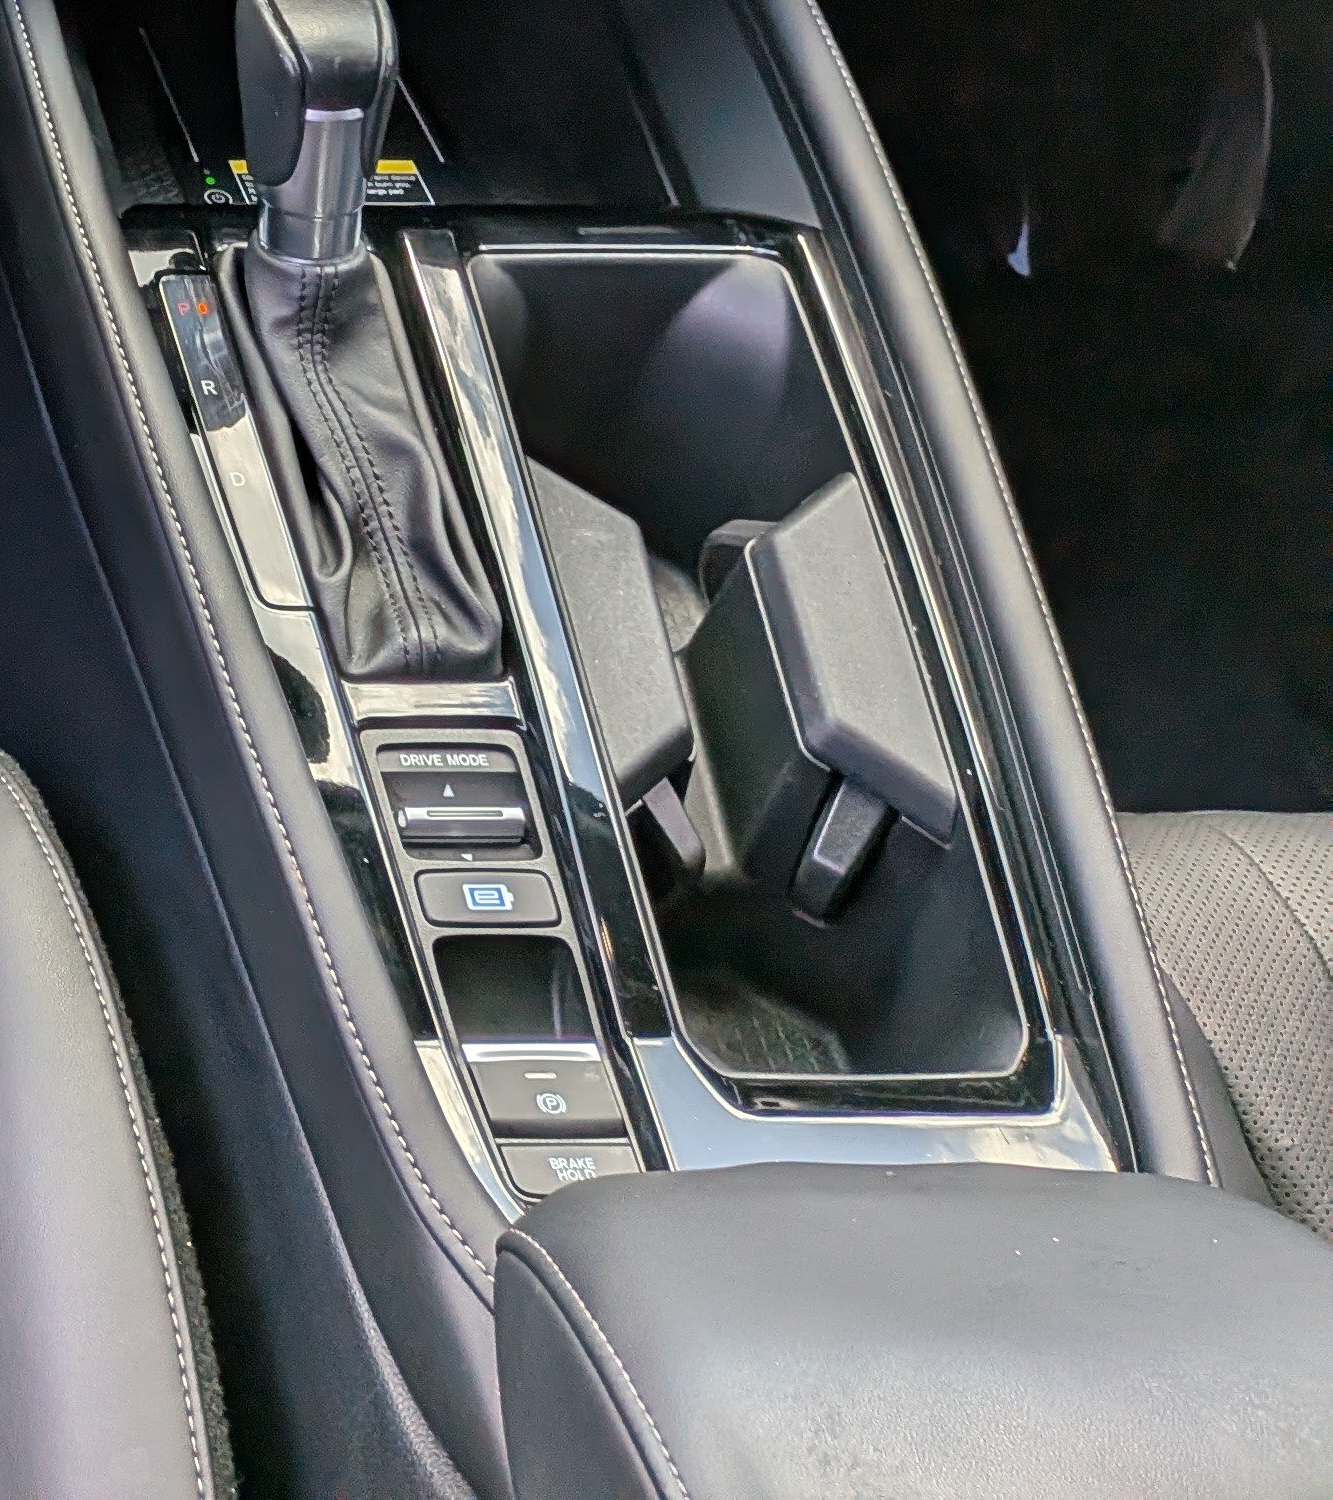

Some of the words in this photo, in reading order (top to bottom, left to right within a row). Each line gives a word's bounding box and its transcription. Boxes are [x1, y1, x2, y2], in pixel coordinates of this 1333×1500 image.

[201, 380, 218, 396] R
[229, 472, 246, 488] D
[399, 753, 442, 767] DRIVE
[445, 753, 490, 768] MODE
[548, 1156, 597, 1171] BRAKE
